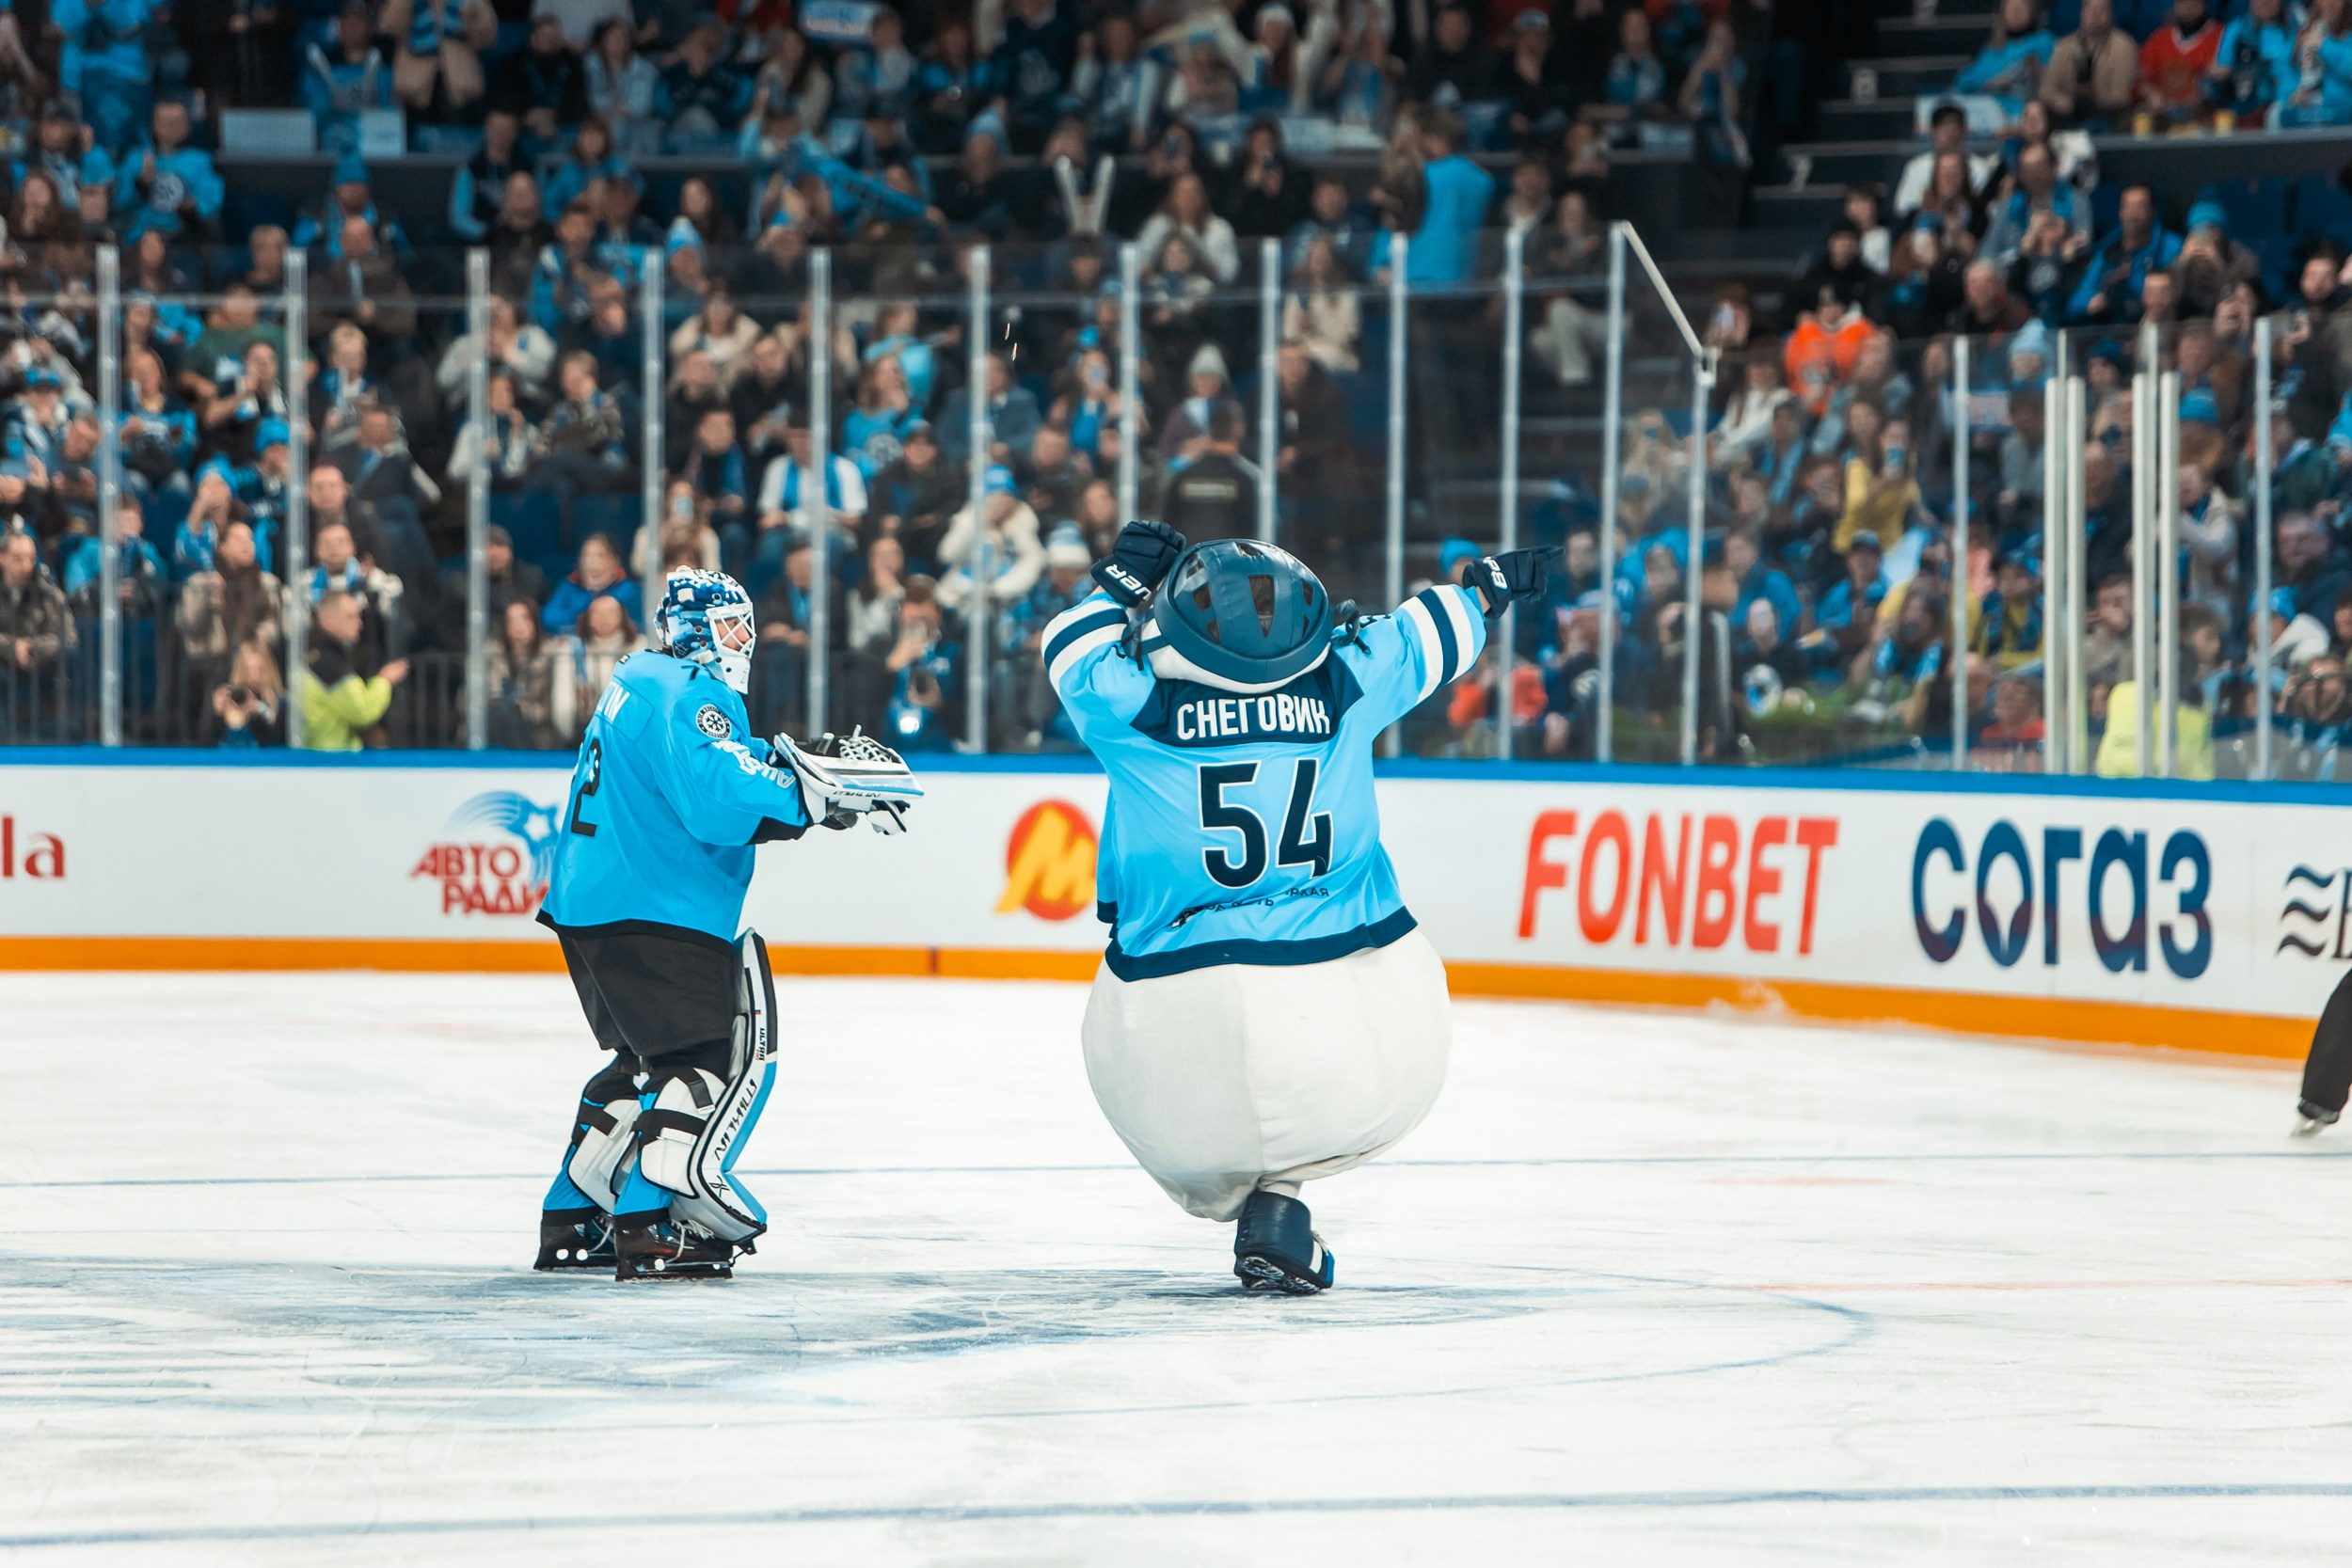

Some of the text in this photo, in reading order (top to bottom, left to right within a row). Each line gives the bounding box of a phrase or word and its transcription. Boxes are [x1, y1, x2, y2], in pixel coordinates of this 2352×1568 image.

[1177, 693, 1330, 740] СНЕГОВИК
[410, 845, 521, 878] АВТО
[1197, 757, 1334, 889] 54
[1518, 809, 1839, 956] FONBET
